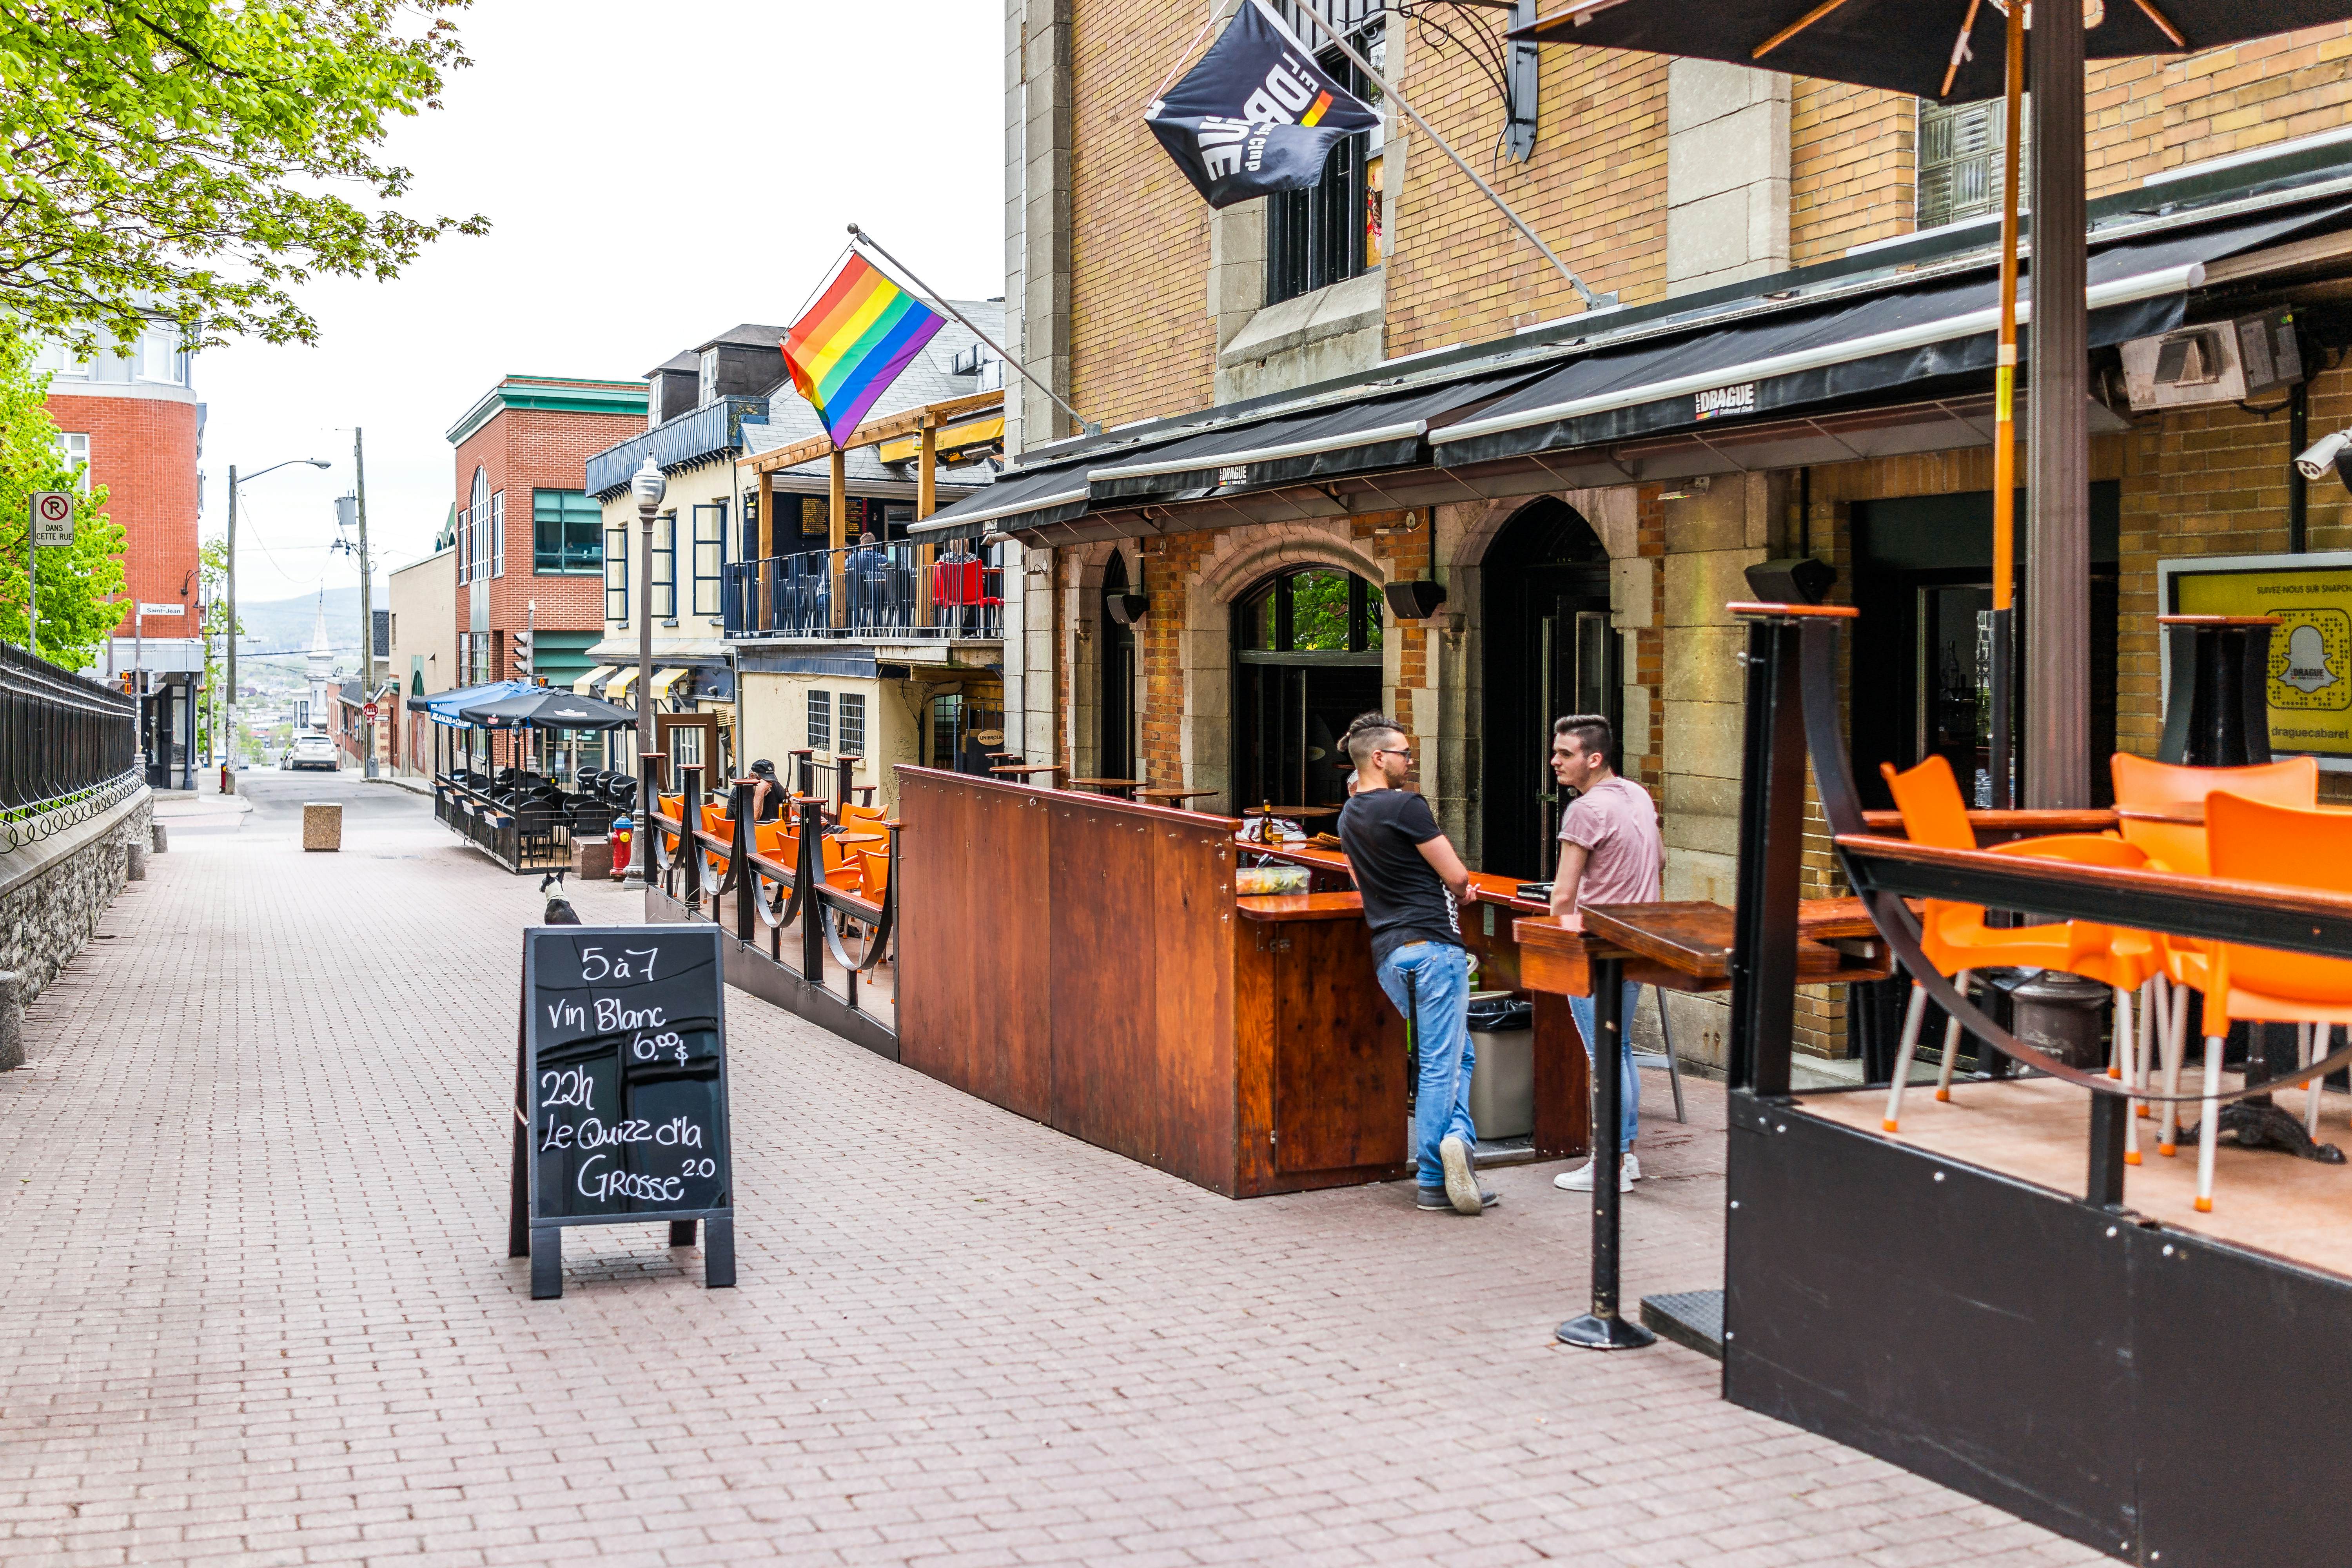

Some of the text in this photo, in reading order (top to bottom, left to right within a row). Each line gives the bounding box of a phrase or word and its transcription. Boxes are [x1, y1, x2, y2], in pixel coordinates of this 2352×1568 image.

[1695, 394, 1700, 413] LE
[1700, 384, 1754, 412] DRAGUE
[1222, 465, 1247, 481] DRAGUE
[2293, 668, 2324, 677] DRAGUE
[431, 712, 452, 724] BLANCHE
[2272, 726, 2349, 739] draguecabaret
[548, 998, 666, 1031] Vin Blanc
[542, 1065, 595, 1111] 22h
[542, 1114, 573, 1152] Le
[578, 1118, 653, 1149] Quizz
